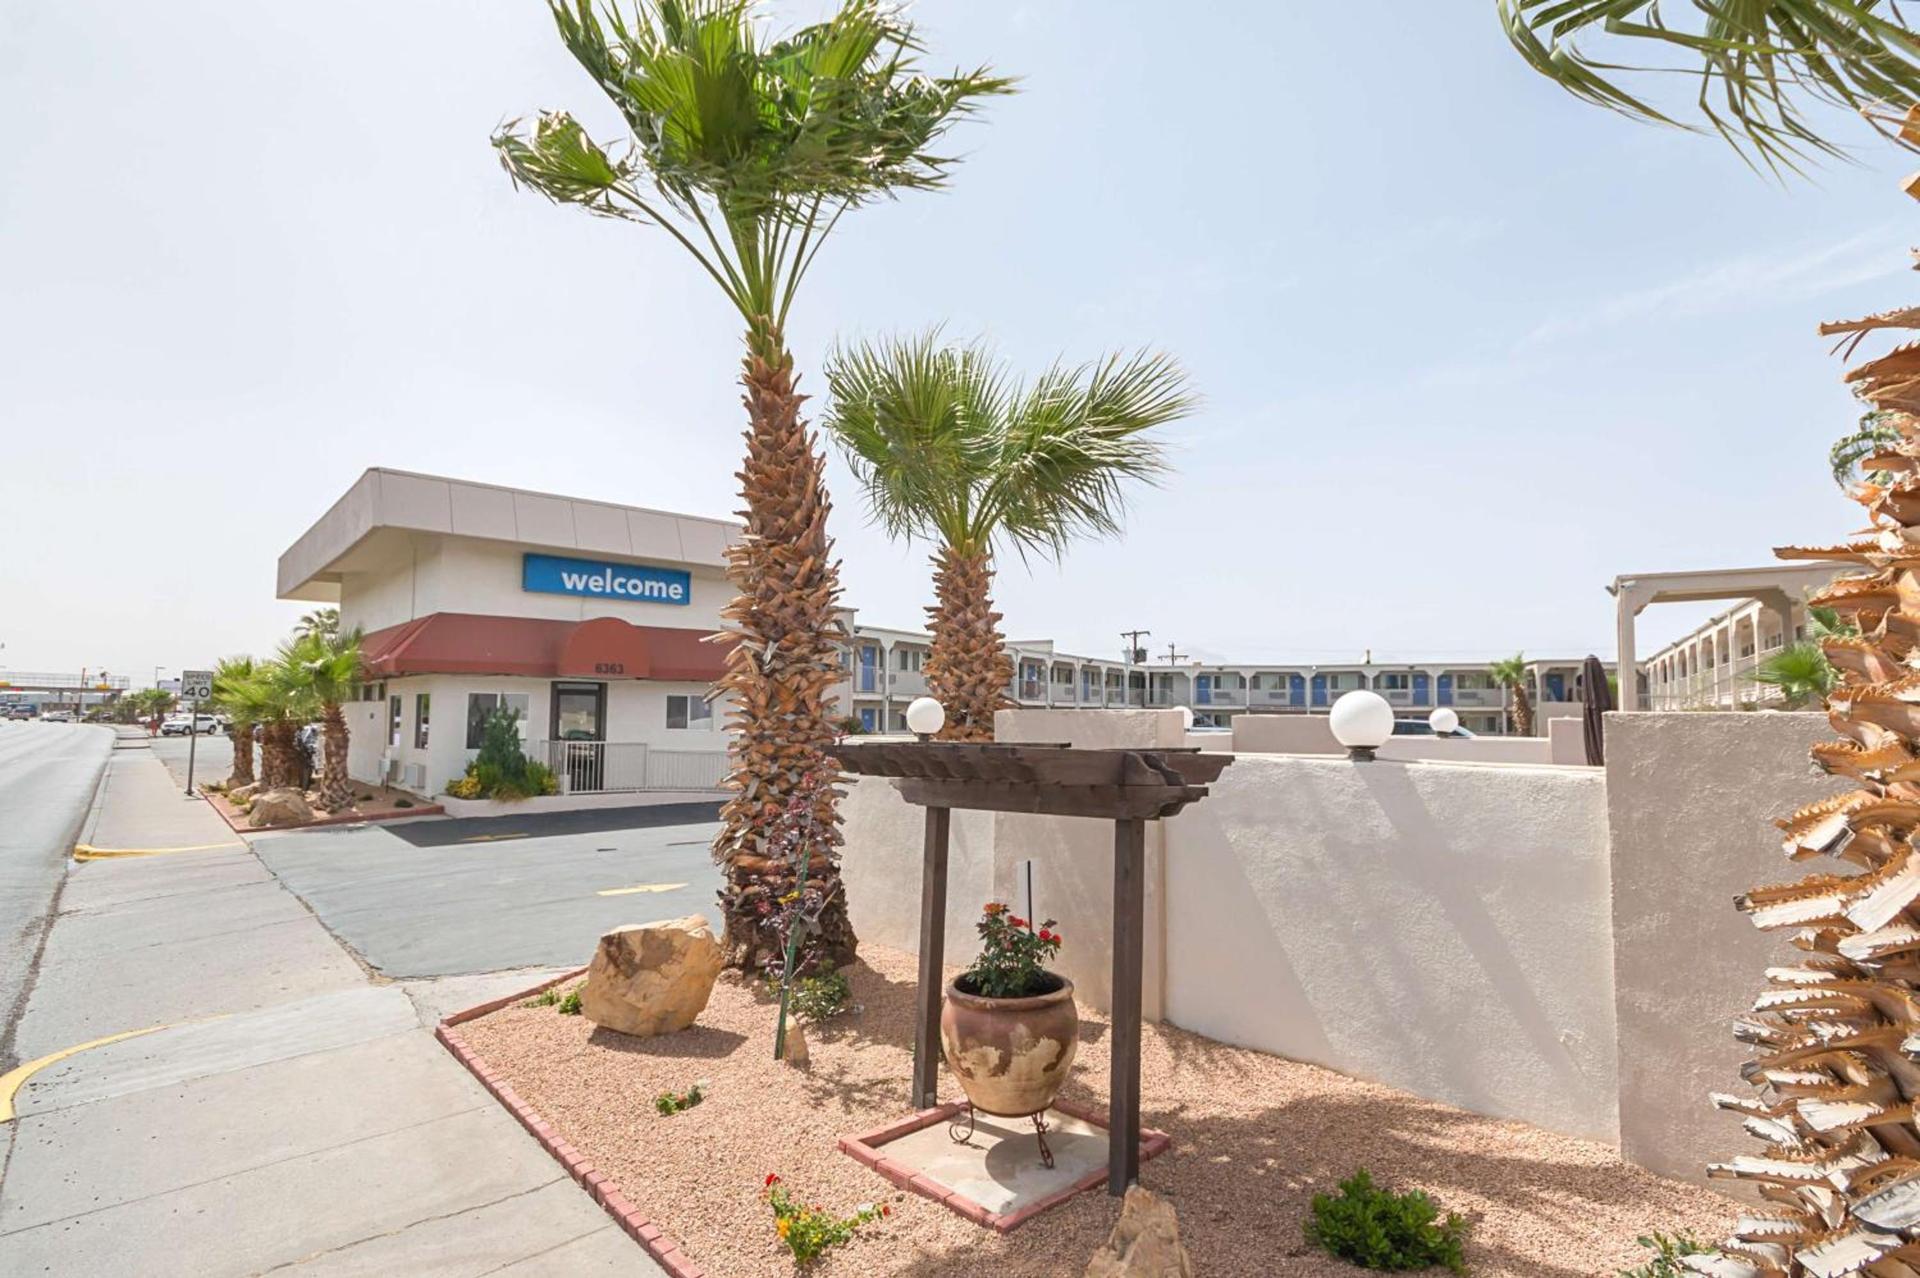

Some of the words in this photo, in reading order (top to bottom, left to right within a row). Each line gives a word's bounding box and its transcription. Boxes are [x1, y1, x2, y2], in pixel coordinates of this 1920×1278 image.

[561, 568, 683, 600] welcome
[595, 663, 624, 675] 6363
[184, 687, 210, 698] 40
